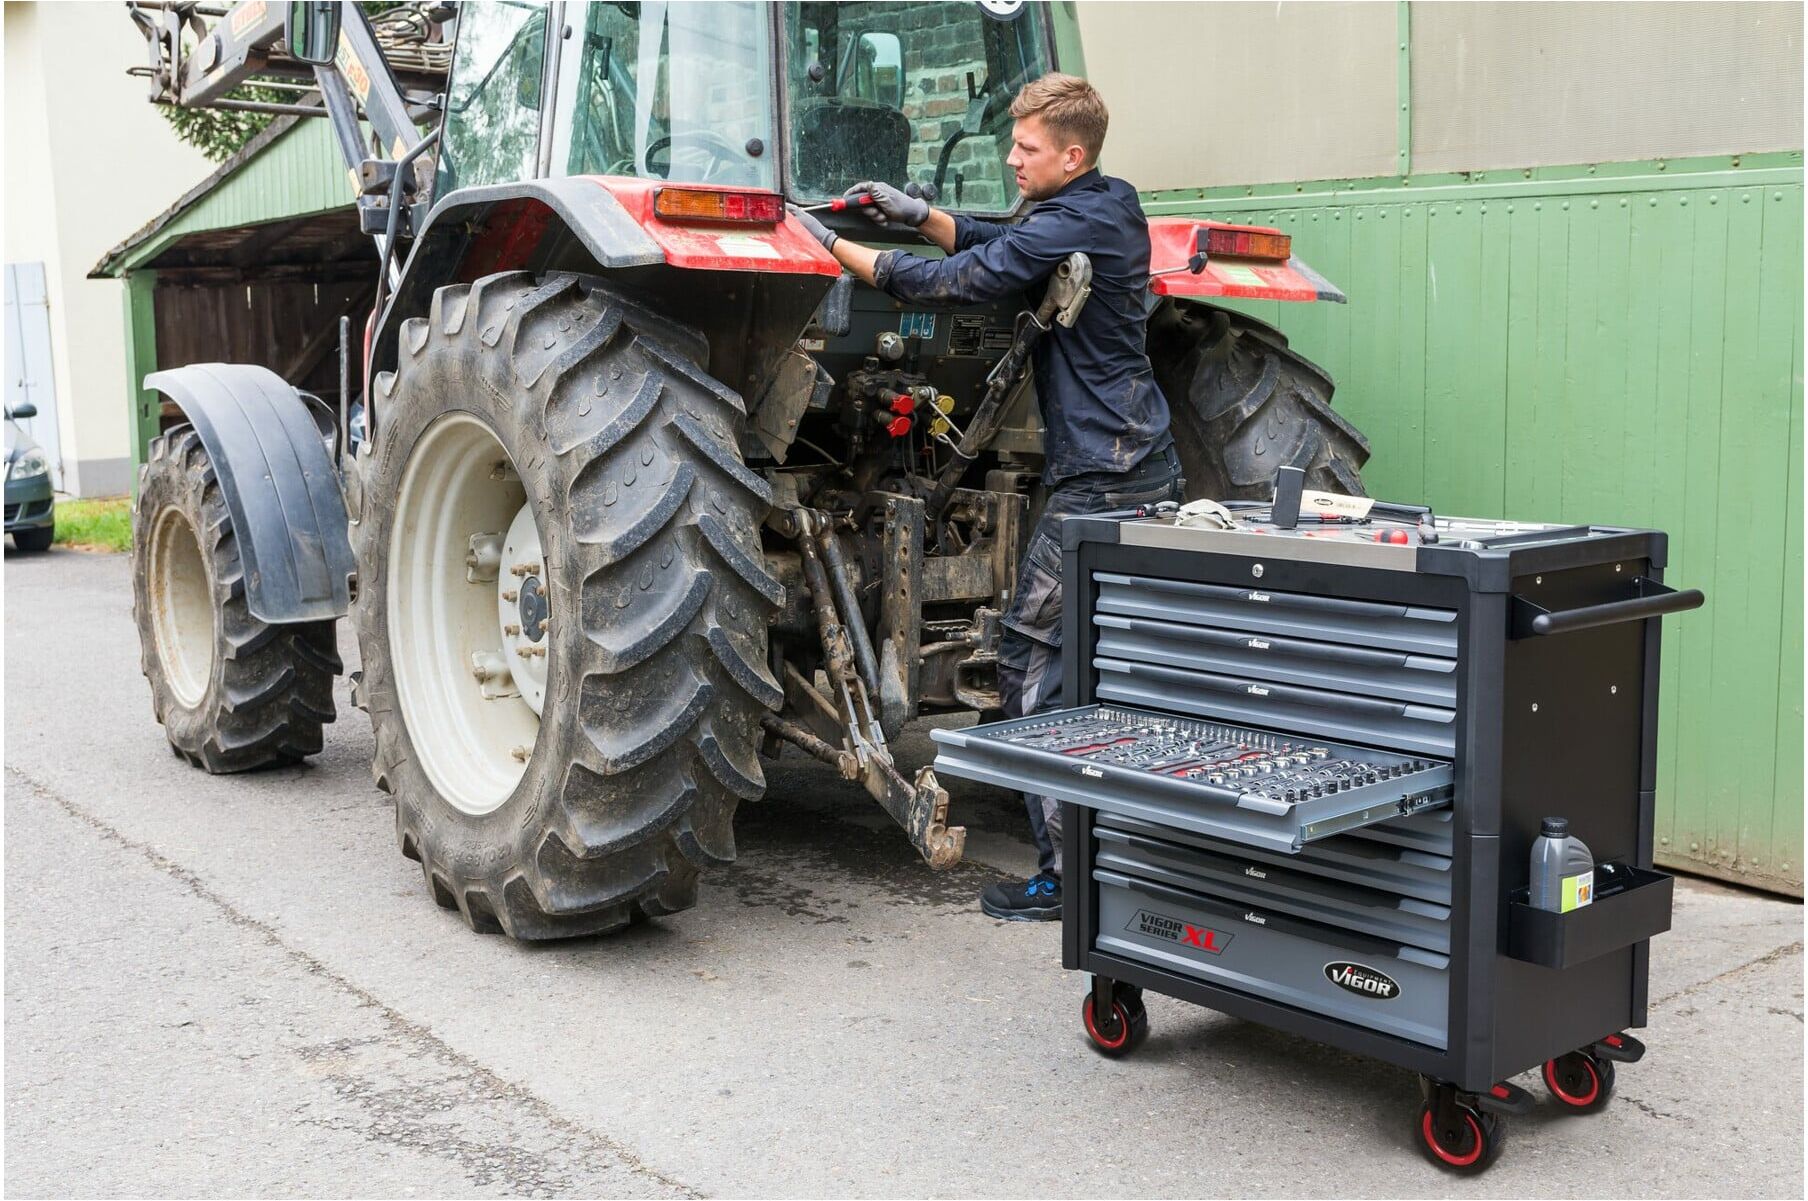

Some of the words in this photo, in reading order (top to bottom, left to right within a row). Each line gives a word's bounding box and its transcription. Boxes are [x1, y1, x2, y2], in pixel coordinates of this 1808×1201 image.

[1245, 866, 1267, 879] VIGOR
[1140, 913, 1183, 933] VIGOR
[1245, 911, 1266, 925] VIGOR
[1139, 923, 1179, 940] SERIES
[1181, 923, 1220, 953] XL
[1332, 965, 1391, 997] VIGOR
